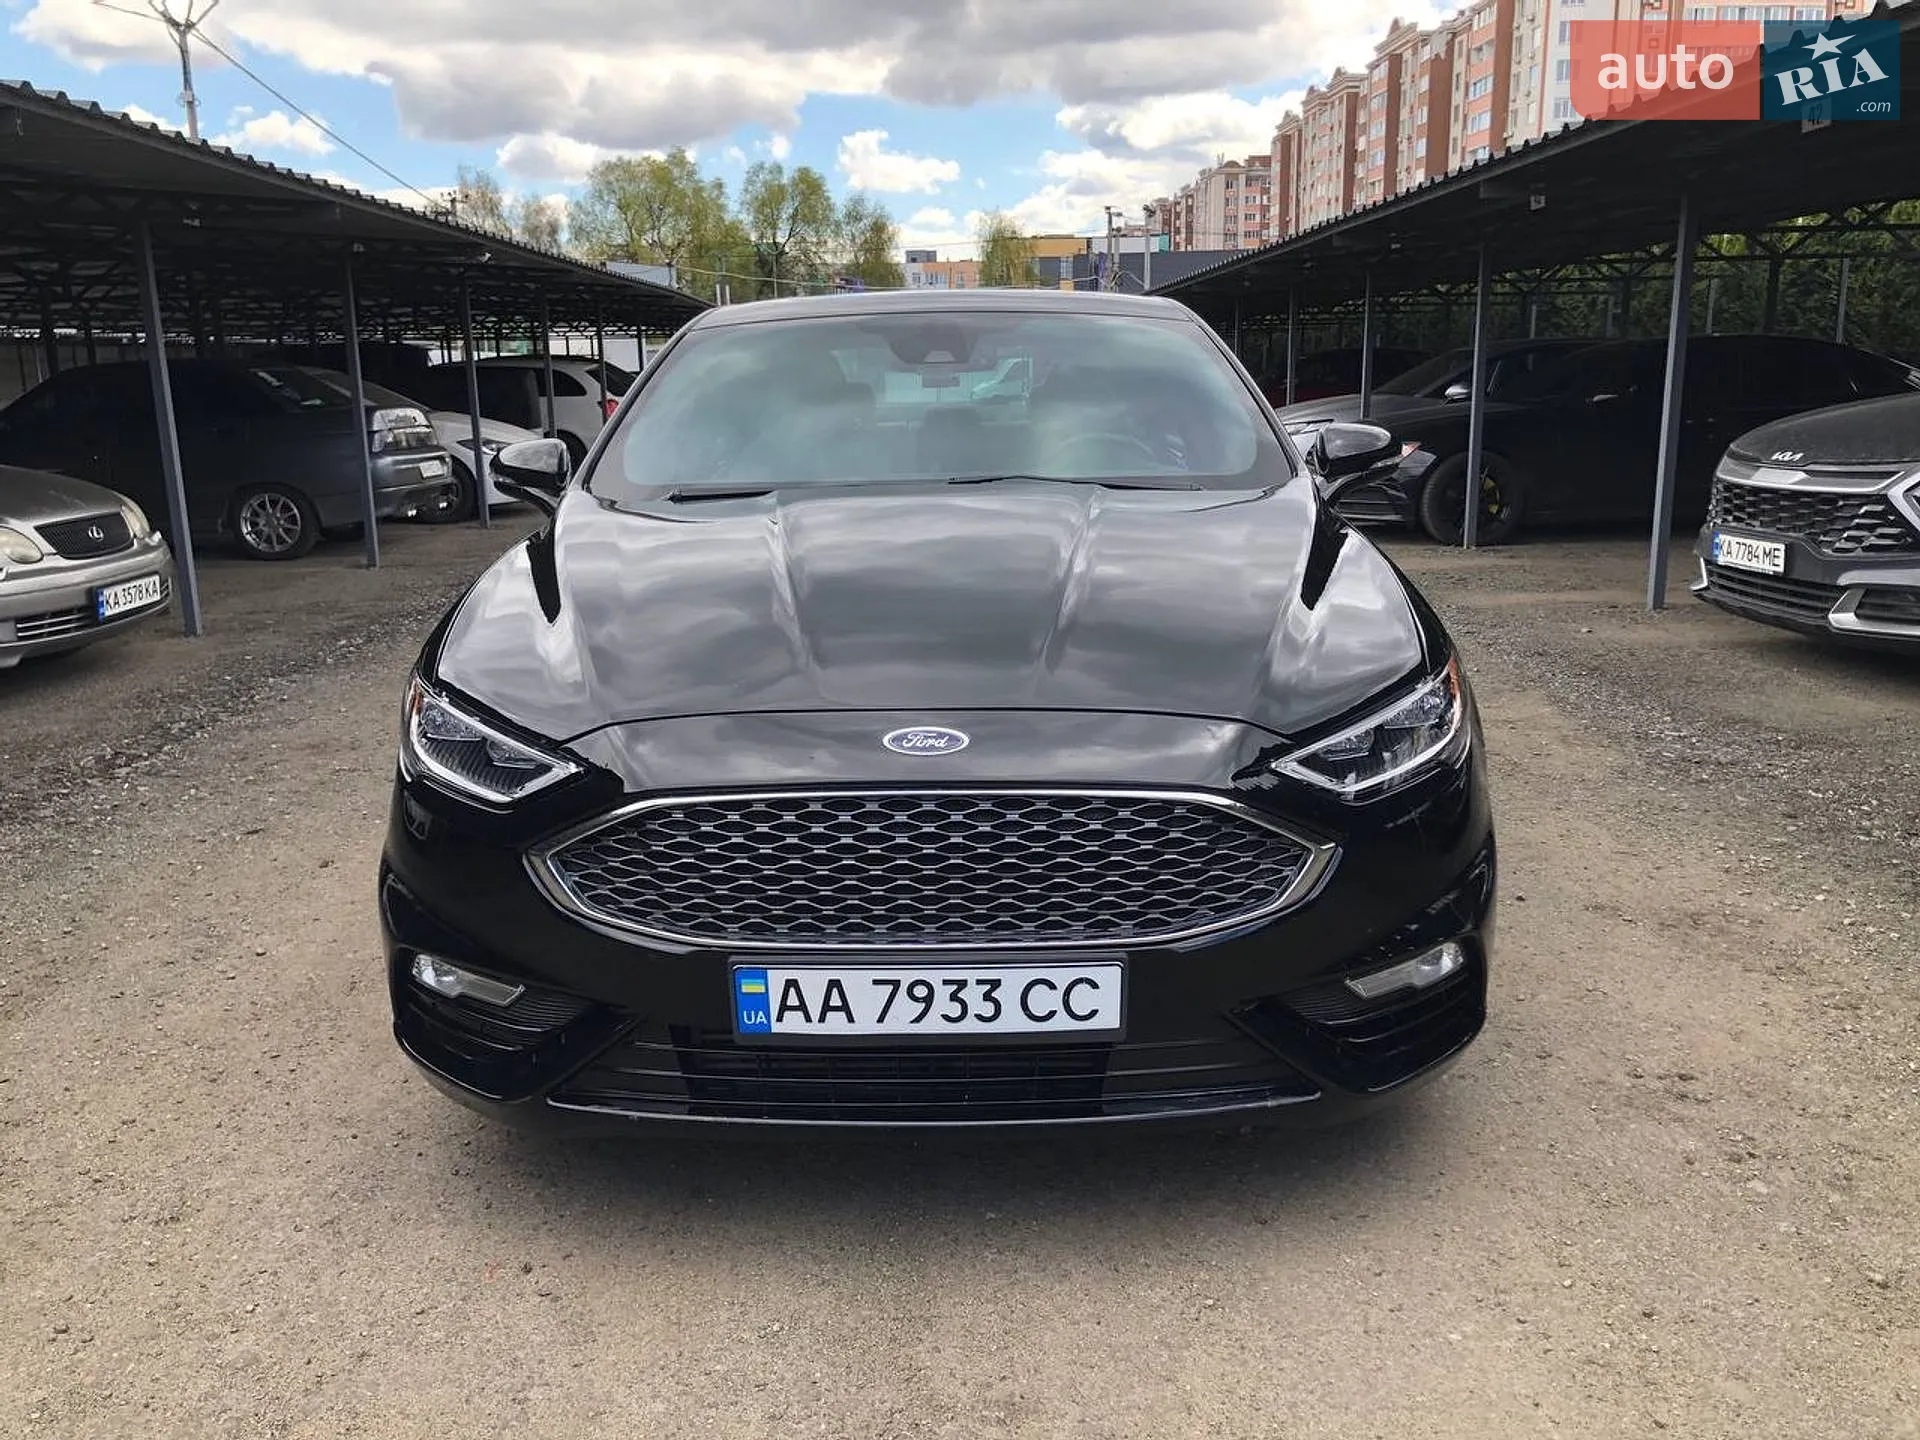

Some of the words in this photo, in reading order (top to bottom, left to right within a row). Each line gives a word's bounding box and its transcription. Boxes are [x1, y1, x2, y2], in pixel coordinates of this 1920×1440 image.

[1735, 541, 1760, 564] 7784
[1762, 546, 1781, 568] ME
[105, 591, 120, 610] KA
[122, 583, 143, 606] 3578
[144, 579, 159, 600] KA
[902, 732, 950, 748] Ford
[775, 978, 855, 1024] AA
[871, 978, 1001, 1024] 7933
[1019, 977, 1100, 1023] CC
[743, 1011, 768, 1025] UA
